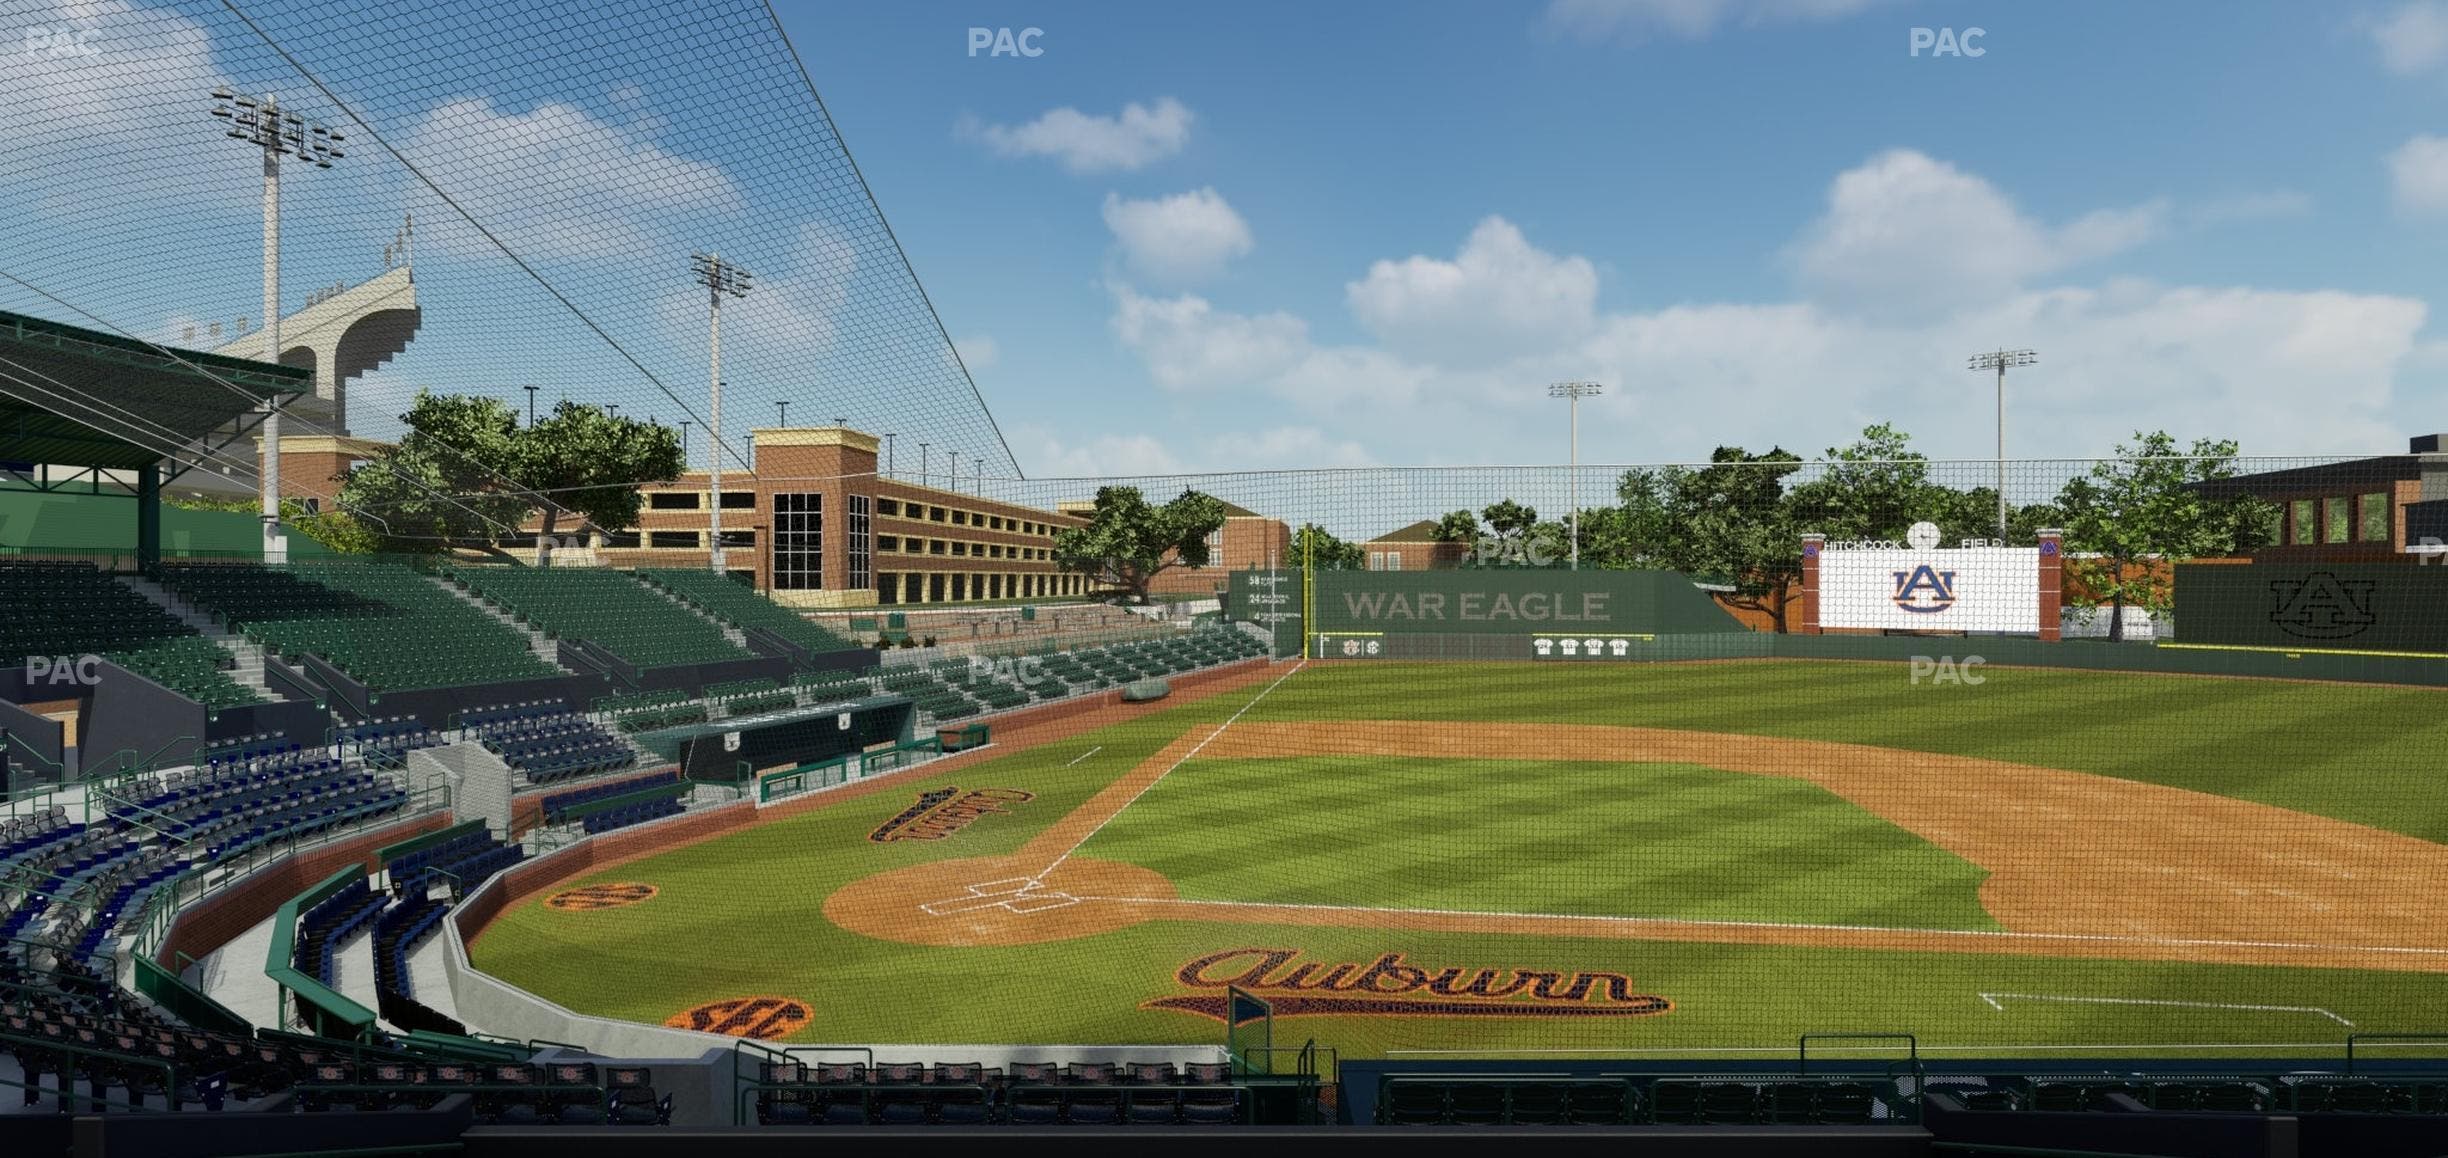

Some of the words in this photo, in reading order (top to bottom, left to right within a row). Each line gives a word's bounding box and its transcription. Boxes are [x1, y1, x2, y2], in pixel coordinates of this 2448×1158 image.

[1823, 540, 1901, 551] HITCHCOCK
[1961, 538, 2003, 550] FIELD
[1343, 592, 1446, 620] WAR
[1459, 592, 1612, 621] EAGLE
[1174, 947, 1642, 1001] Auburn
